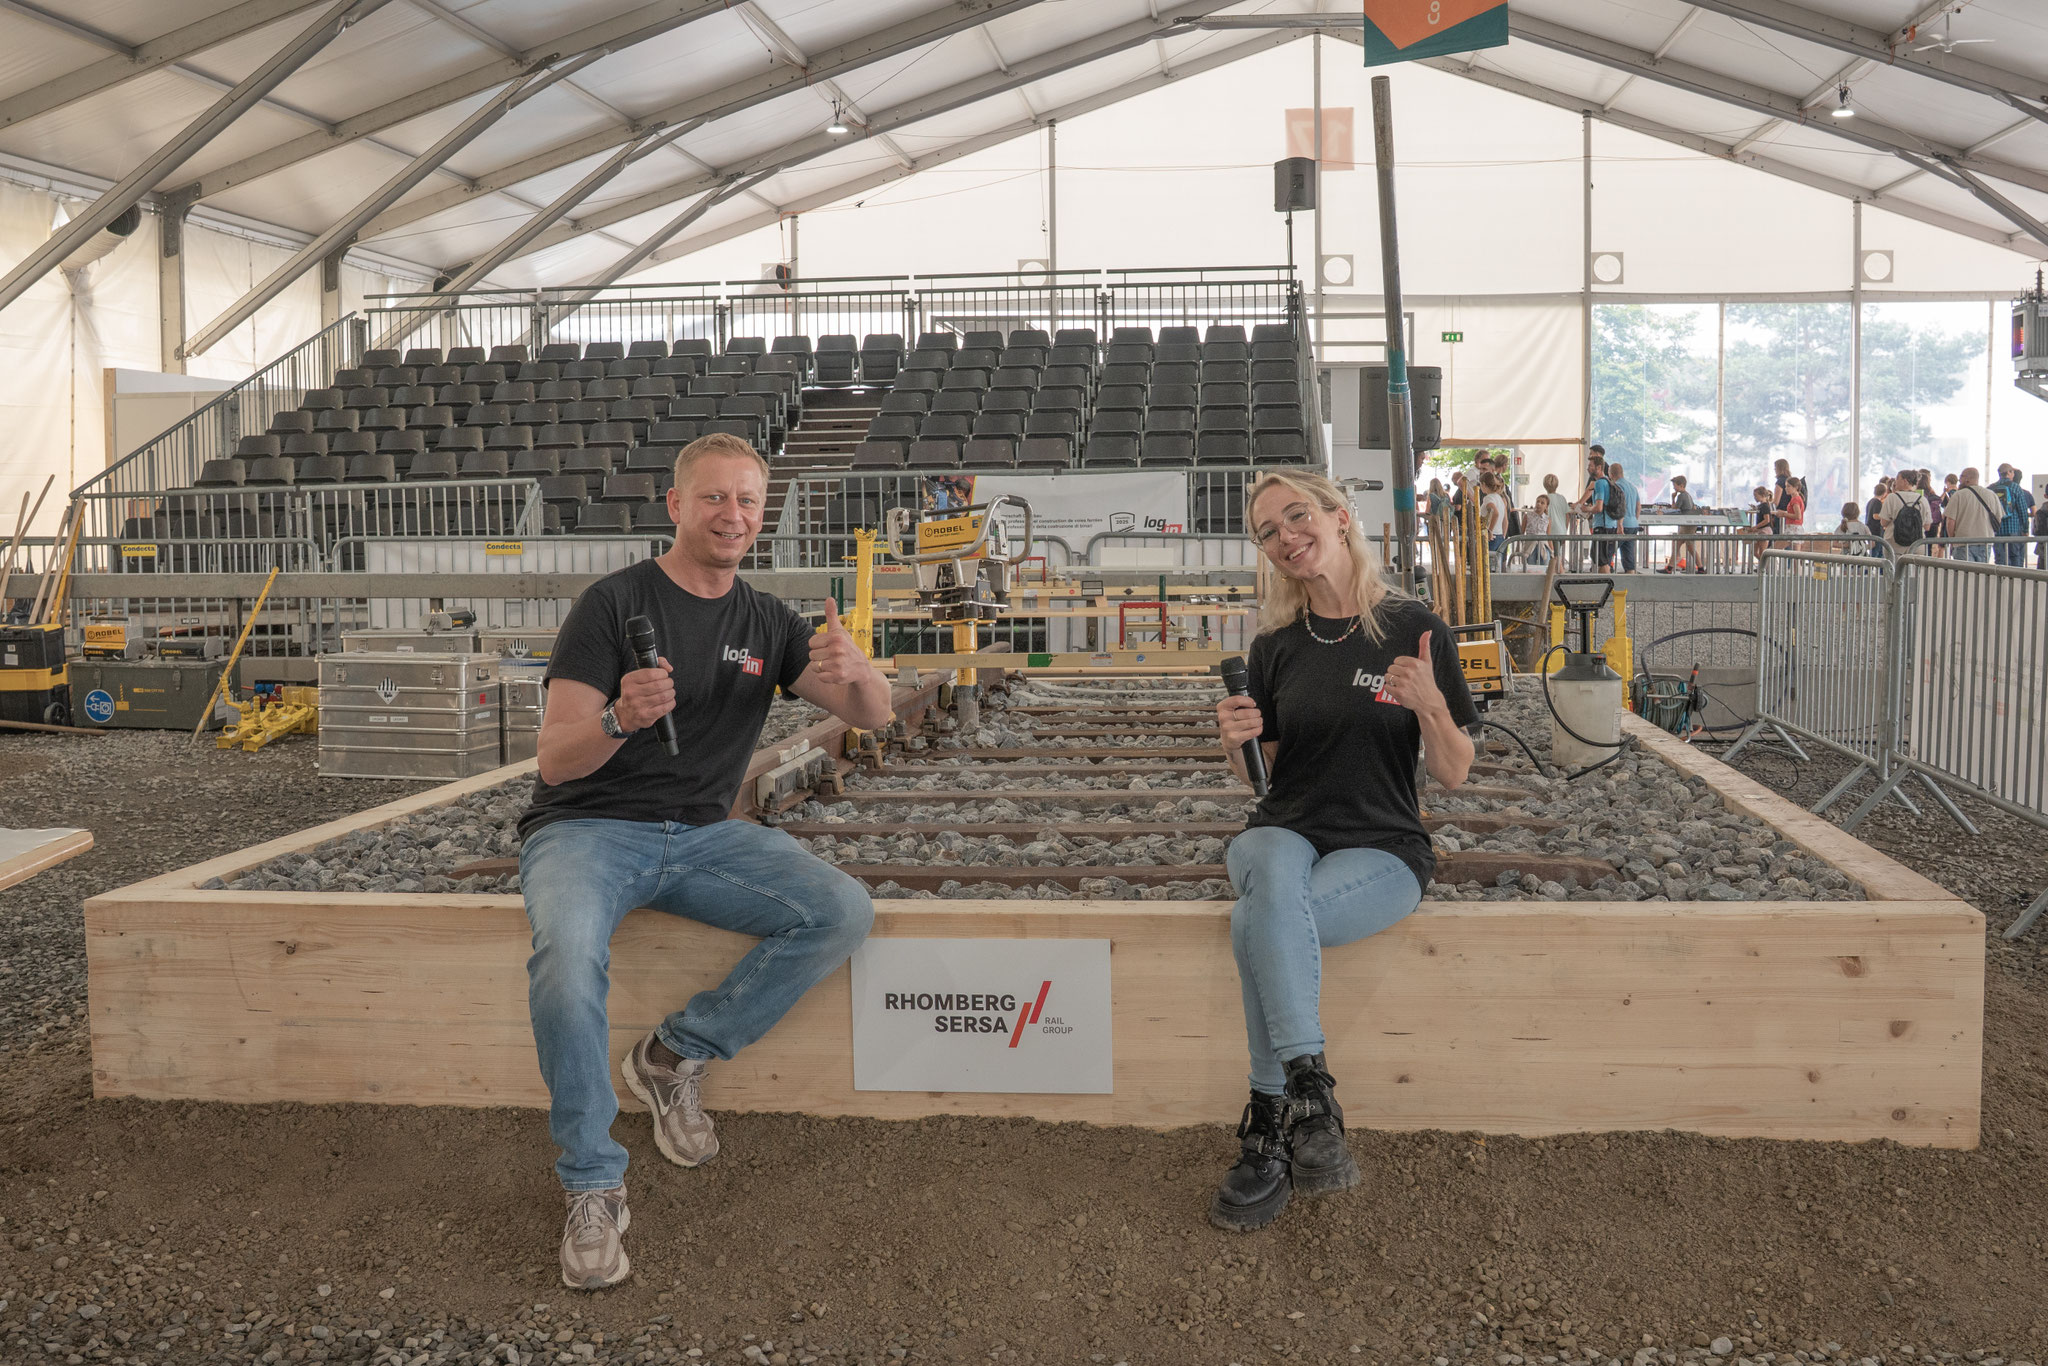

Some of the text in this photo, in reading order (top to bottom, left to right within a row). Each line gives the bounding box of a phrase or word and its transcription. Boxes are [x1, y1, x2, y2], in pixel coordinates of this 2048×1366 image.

[933, 525, 965, 535] ROBEL
[95, 629, 123, 638] ROBEL
[723, 645, 749, 664] log
[1459, 658, 1497, 670] BEL
[1352, 668, 1386, 693] log
[885, 992, 1016, 1012] RHOMBERG
[934, 1015, 1009, 1034] SERSA
[1044, 1016, 1065, 1025] RAIL
[1042, 1026, 1074, 1035] GROUP
